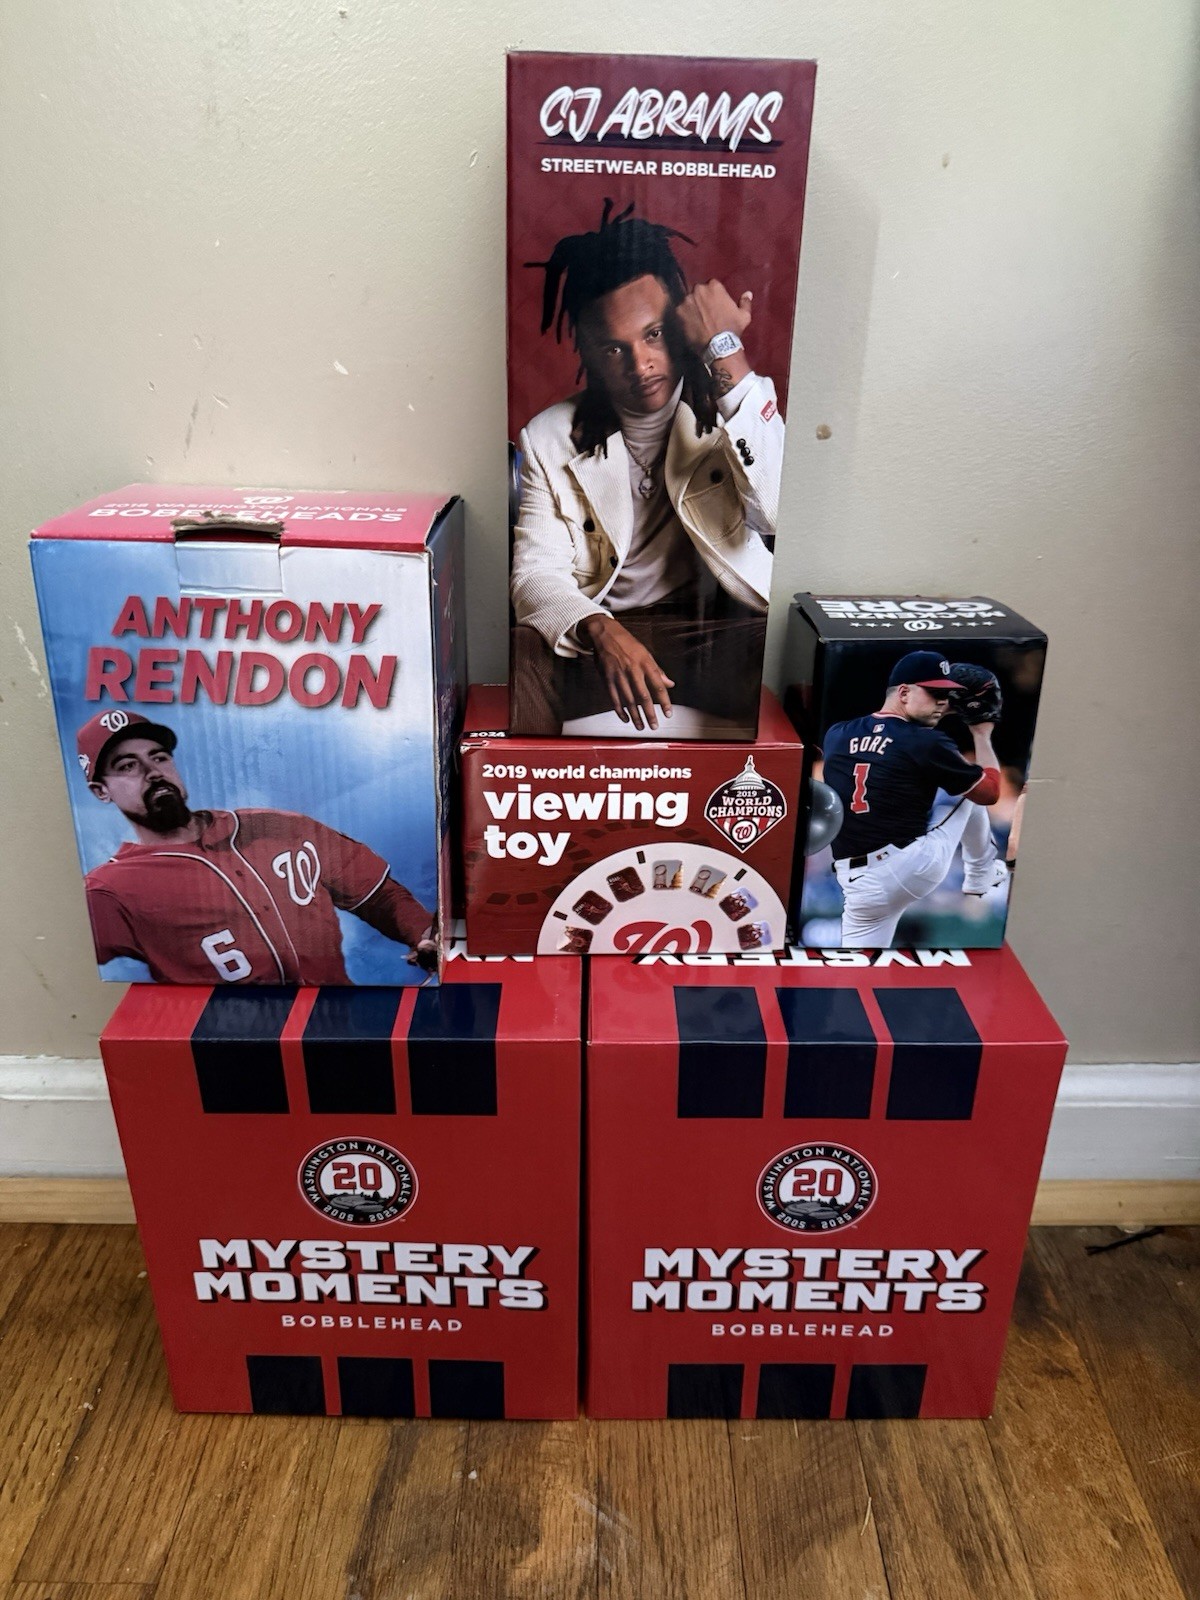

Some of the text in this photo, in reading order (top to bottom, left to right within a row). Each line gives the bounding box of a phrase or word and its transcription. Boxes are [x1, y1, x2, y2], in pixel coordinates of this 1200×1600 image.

[540, 86, 783, 152] CJ ABRAMS
[541, 158, 776, 179] STREETWEAR BOBBLEHEAD
[112, 596, 382, 643] ANTHONY
[816, 600, 993, 612] GORE
[825, 611, 1006, 619] MACKENZIE
[85, 646, 397, 709] RENDON
[849, 736, 893, 755] GORE
[482, 764, 692, 781] 2019 world champions
[722, 795, 772, 806] WORLD
[850, 763, 871, 814] 1
[483, 784, 689, 827] viewing
[709, 805, 783, 818] CHAMPIONS
[484, 825, 571, 866] toy
[201, 928, 252, 982] 6
[304, 1142, 411, 1204] WASHINGTON NATIONALS
[332, 1162, 383, 1191] 20
[763, 1147, 871, 1211] WASHINGTON NATIONALS
[792, 1168, 843, 1197] 20
[323, 1205, 398, 1222] 2005 2025
[776, 1212, 807, 1229] 2005
[199, 1238, 537, 1276] MYSTERY
[644, 1247, 984, 1280] MYSTERY
[193, 1270, 546, 1310] MOMENTS
[631, 1280, 986, 1312] MOMENTS
[281, 1314, 463, 1332] BOBBLEHEAD
[711, 1323, 895, 1338] BOBBLEHEAD
